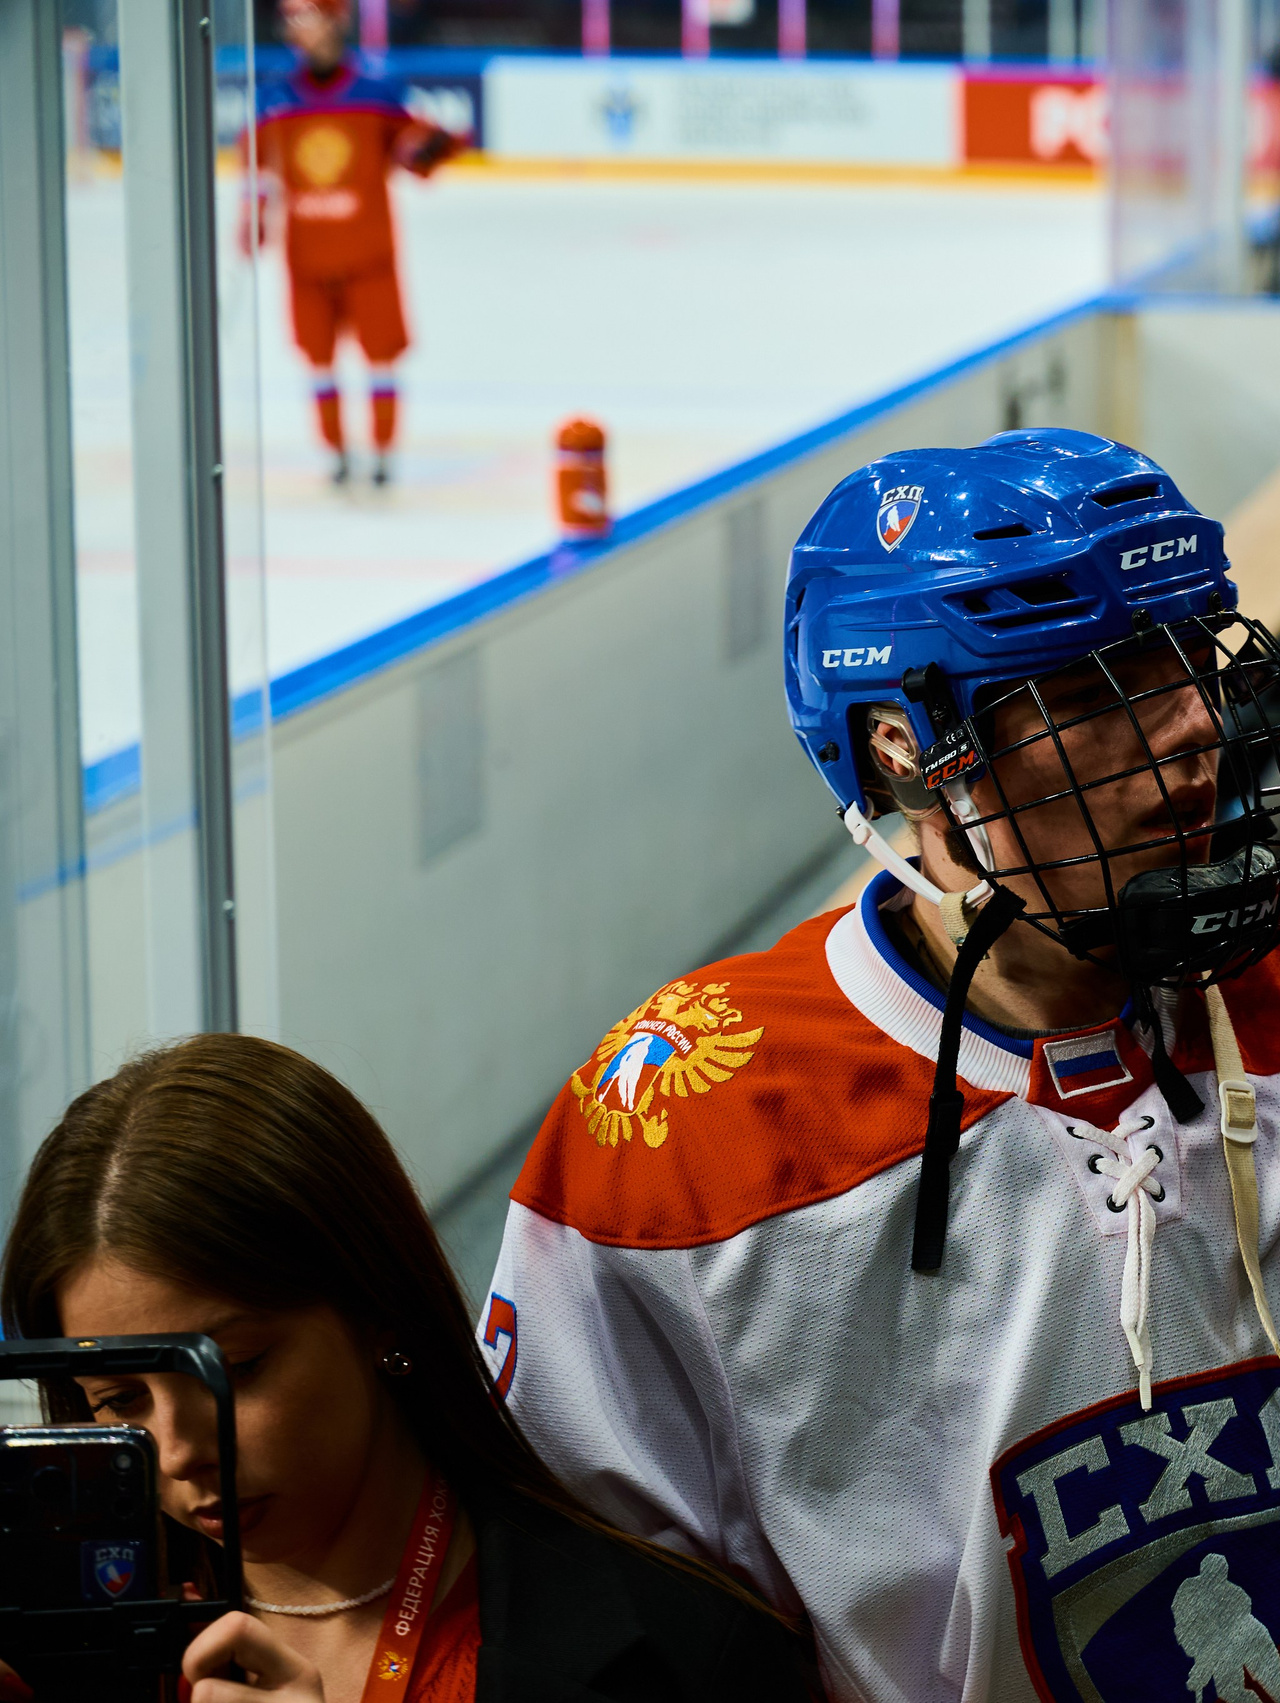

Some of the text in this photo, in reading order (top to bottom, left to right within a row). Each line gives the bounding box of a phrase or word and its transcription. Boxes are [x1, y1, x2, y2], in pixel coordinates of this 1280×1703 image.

[881, 485, 923, 507] СХЛ
[1119, 534, 1197, 571] CCM
[821, 645, 893, 668] CCM
[926, 750, 975, 789] CCM
[1191, 894, 1279, 934] CCM
[662, 1023, 693, 1054] РОССИИ
[395, 1525, 440, 1636] ФЕДЕРАЦИЯ
